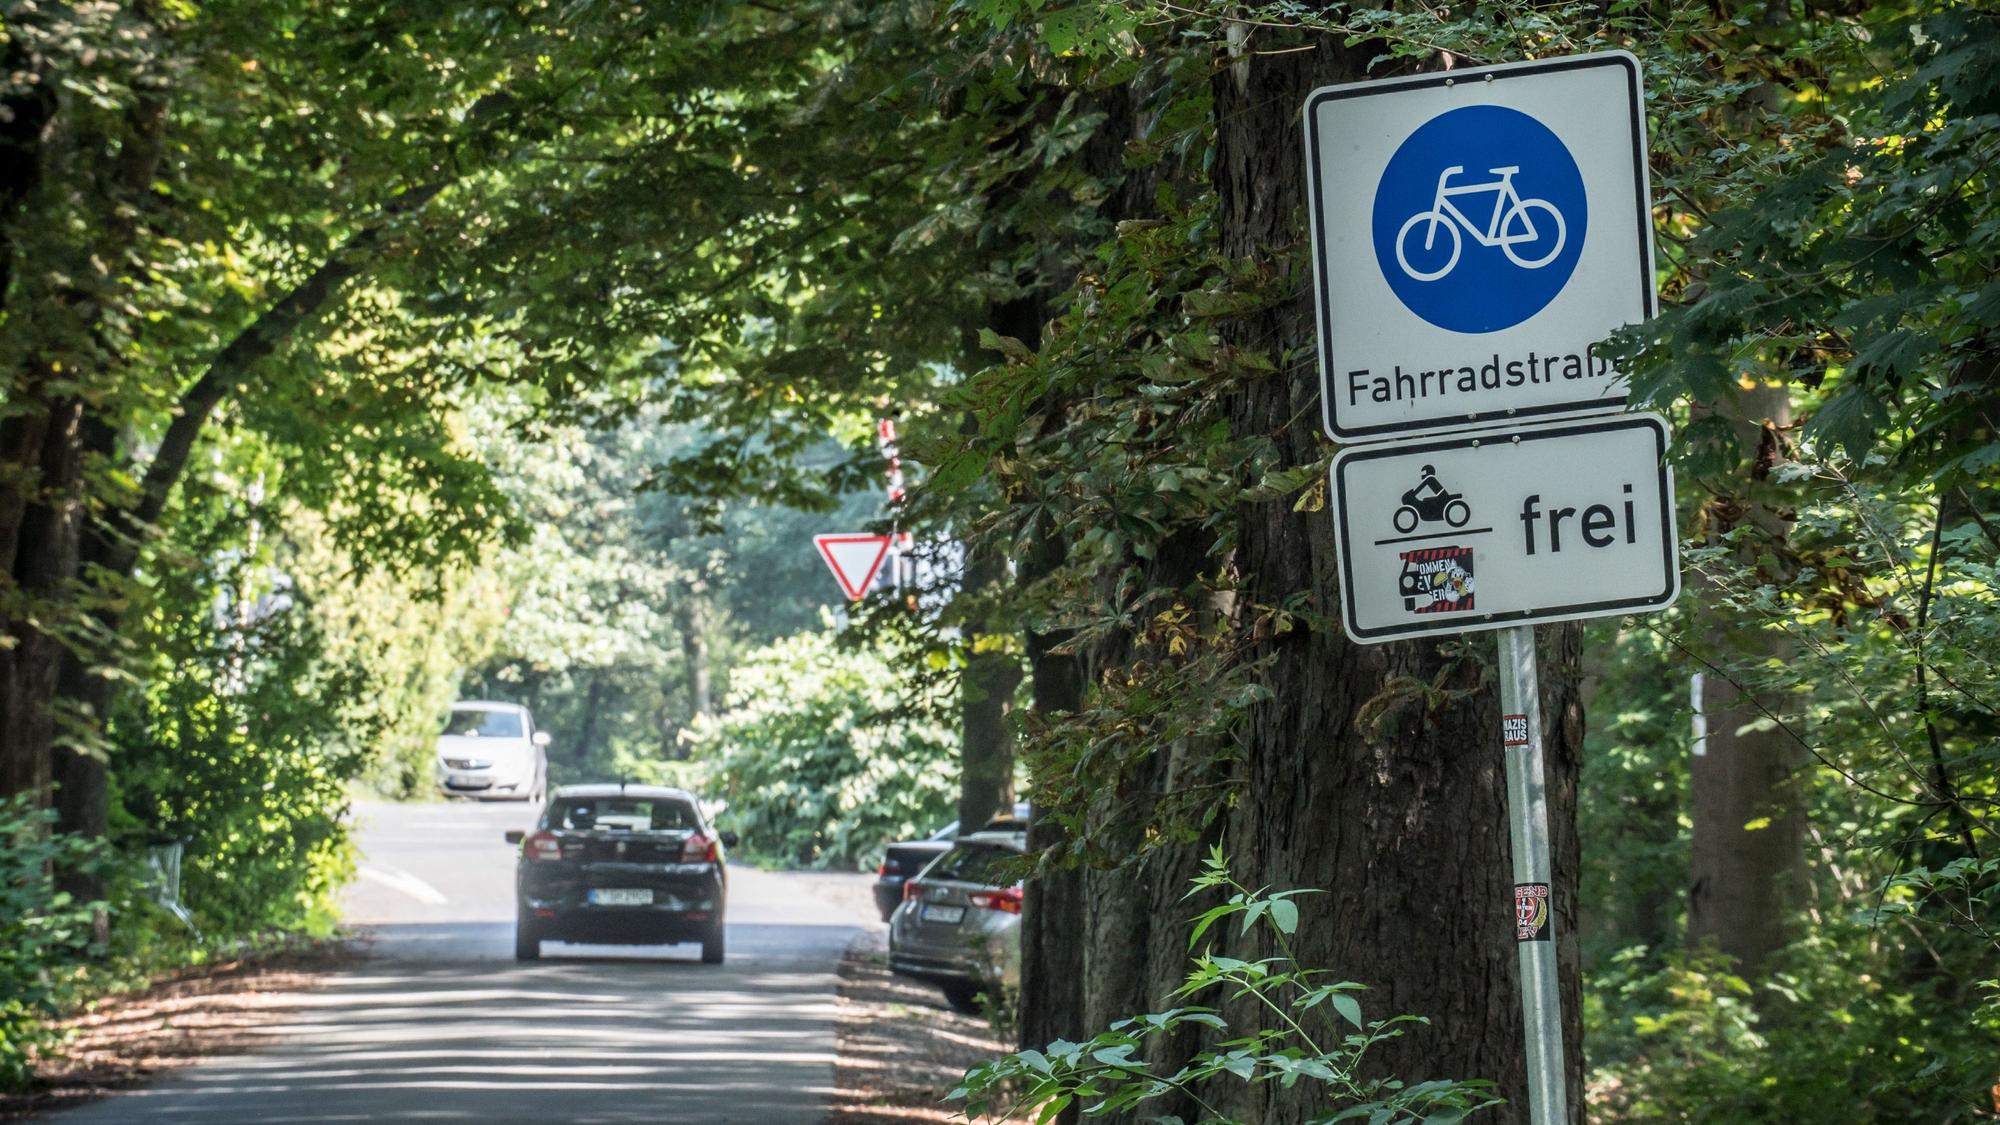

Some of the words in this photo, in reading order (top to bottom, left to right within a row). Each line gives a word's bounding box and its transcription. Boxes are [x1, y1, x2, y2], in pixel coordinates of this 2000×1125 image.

[1520, 483, 1636, 556] frei
[1503, 718, 1527, 731] NAZIS
[1504, 729, 1527, 742] RAUS
